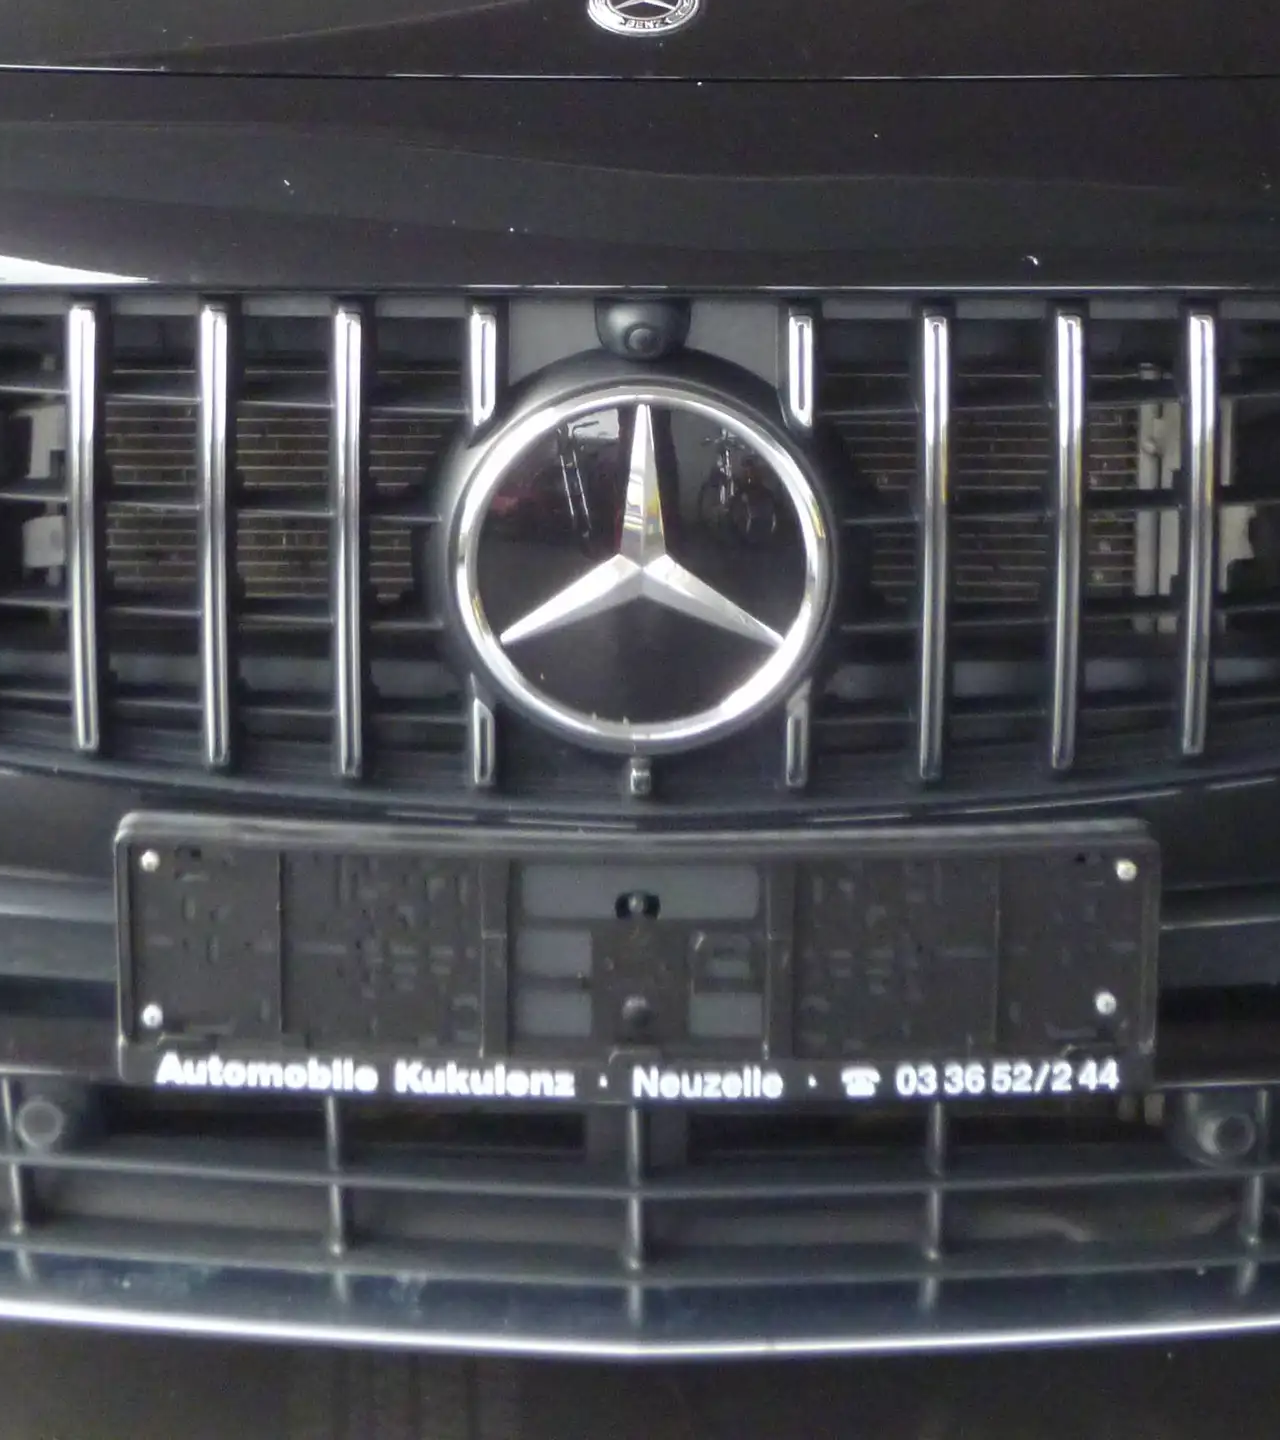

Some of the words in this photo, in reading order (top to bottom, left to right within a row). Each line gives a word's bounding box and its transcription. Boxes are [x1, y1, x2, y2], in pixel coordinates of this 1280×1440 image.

[154, 1051, 380, 1093] Automobile
[393, 1058, 577, 1098] Kukulenz
[631, 1065, 784, 1100] Neuzelle
